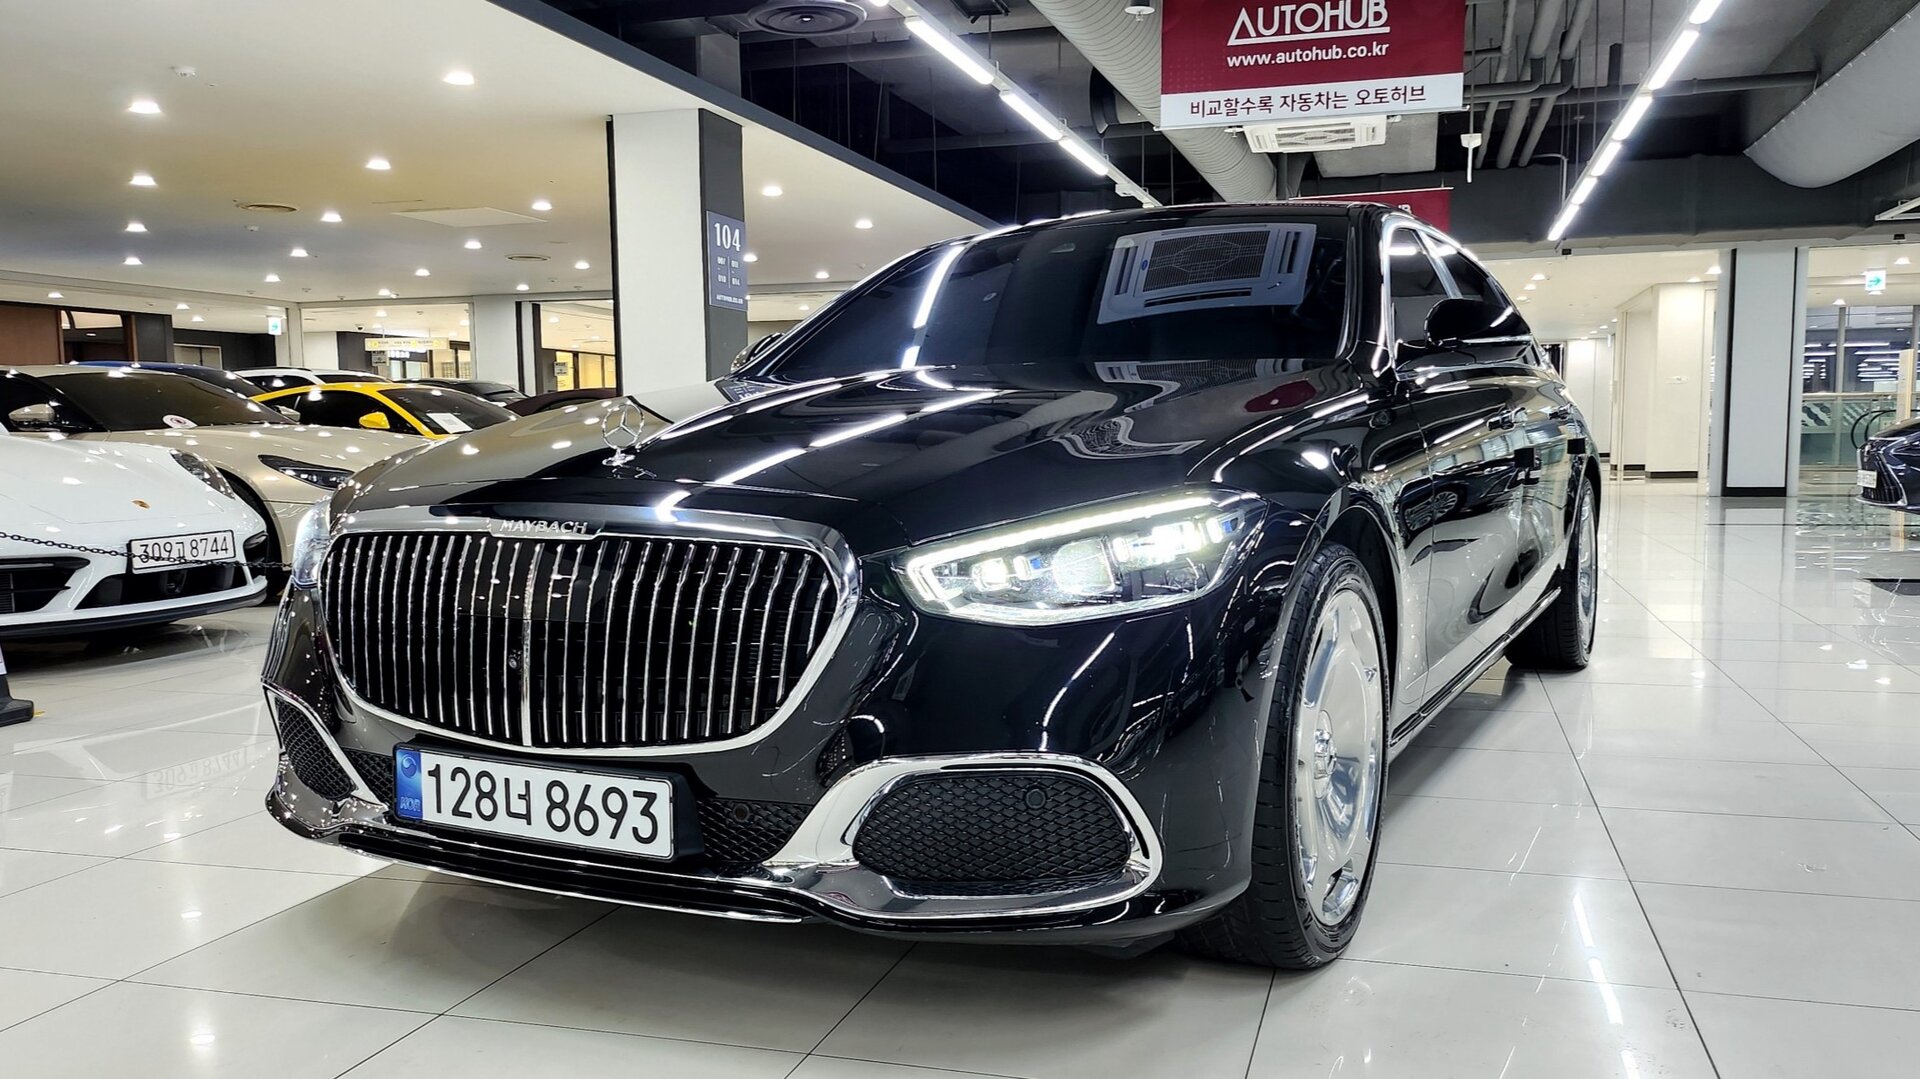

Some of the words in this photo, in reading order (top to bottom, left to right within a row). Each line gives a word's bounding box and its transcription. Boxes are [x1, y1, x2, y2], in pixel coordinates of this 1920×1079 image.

[1227, 0, 1390, 46] AUTOHUB
[1227, 41, 1389, 67] www.autohub.co.kr
[1190, 95, 1273, 118] 비교할수록
[1279, 90, 1348, 113] 자동차는
[1354, 85, 1426, 106] 오토허브
[714, 222, 741, 251] 104
[500, 519, 588, 534] MAYBACH
[140, 541, 186, 563] 309기
[190, 536, 229, 558] 8744
[428, 763, 532, 826] 128너
[546, 780, 658, 844] 8693
